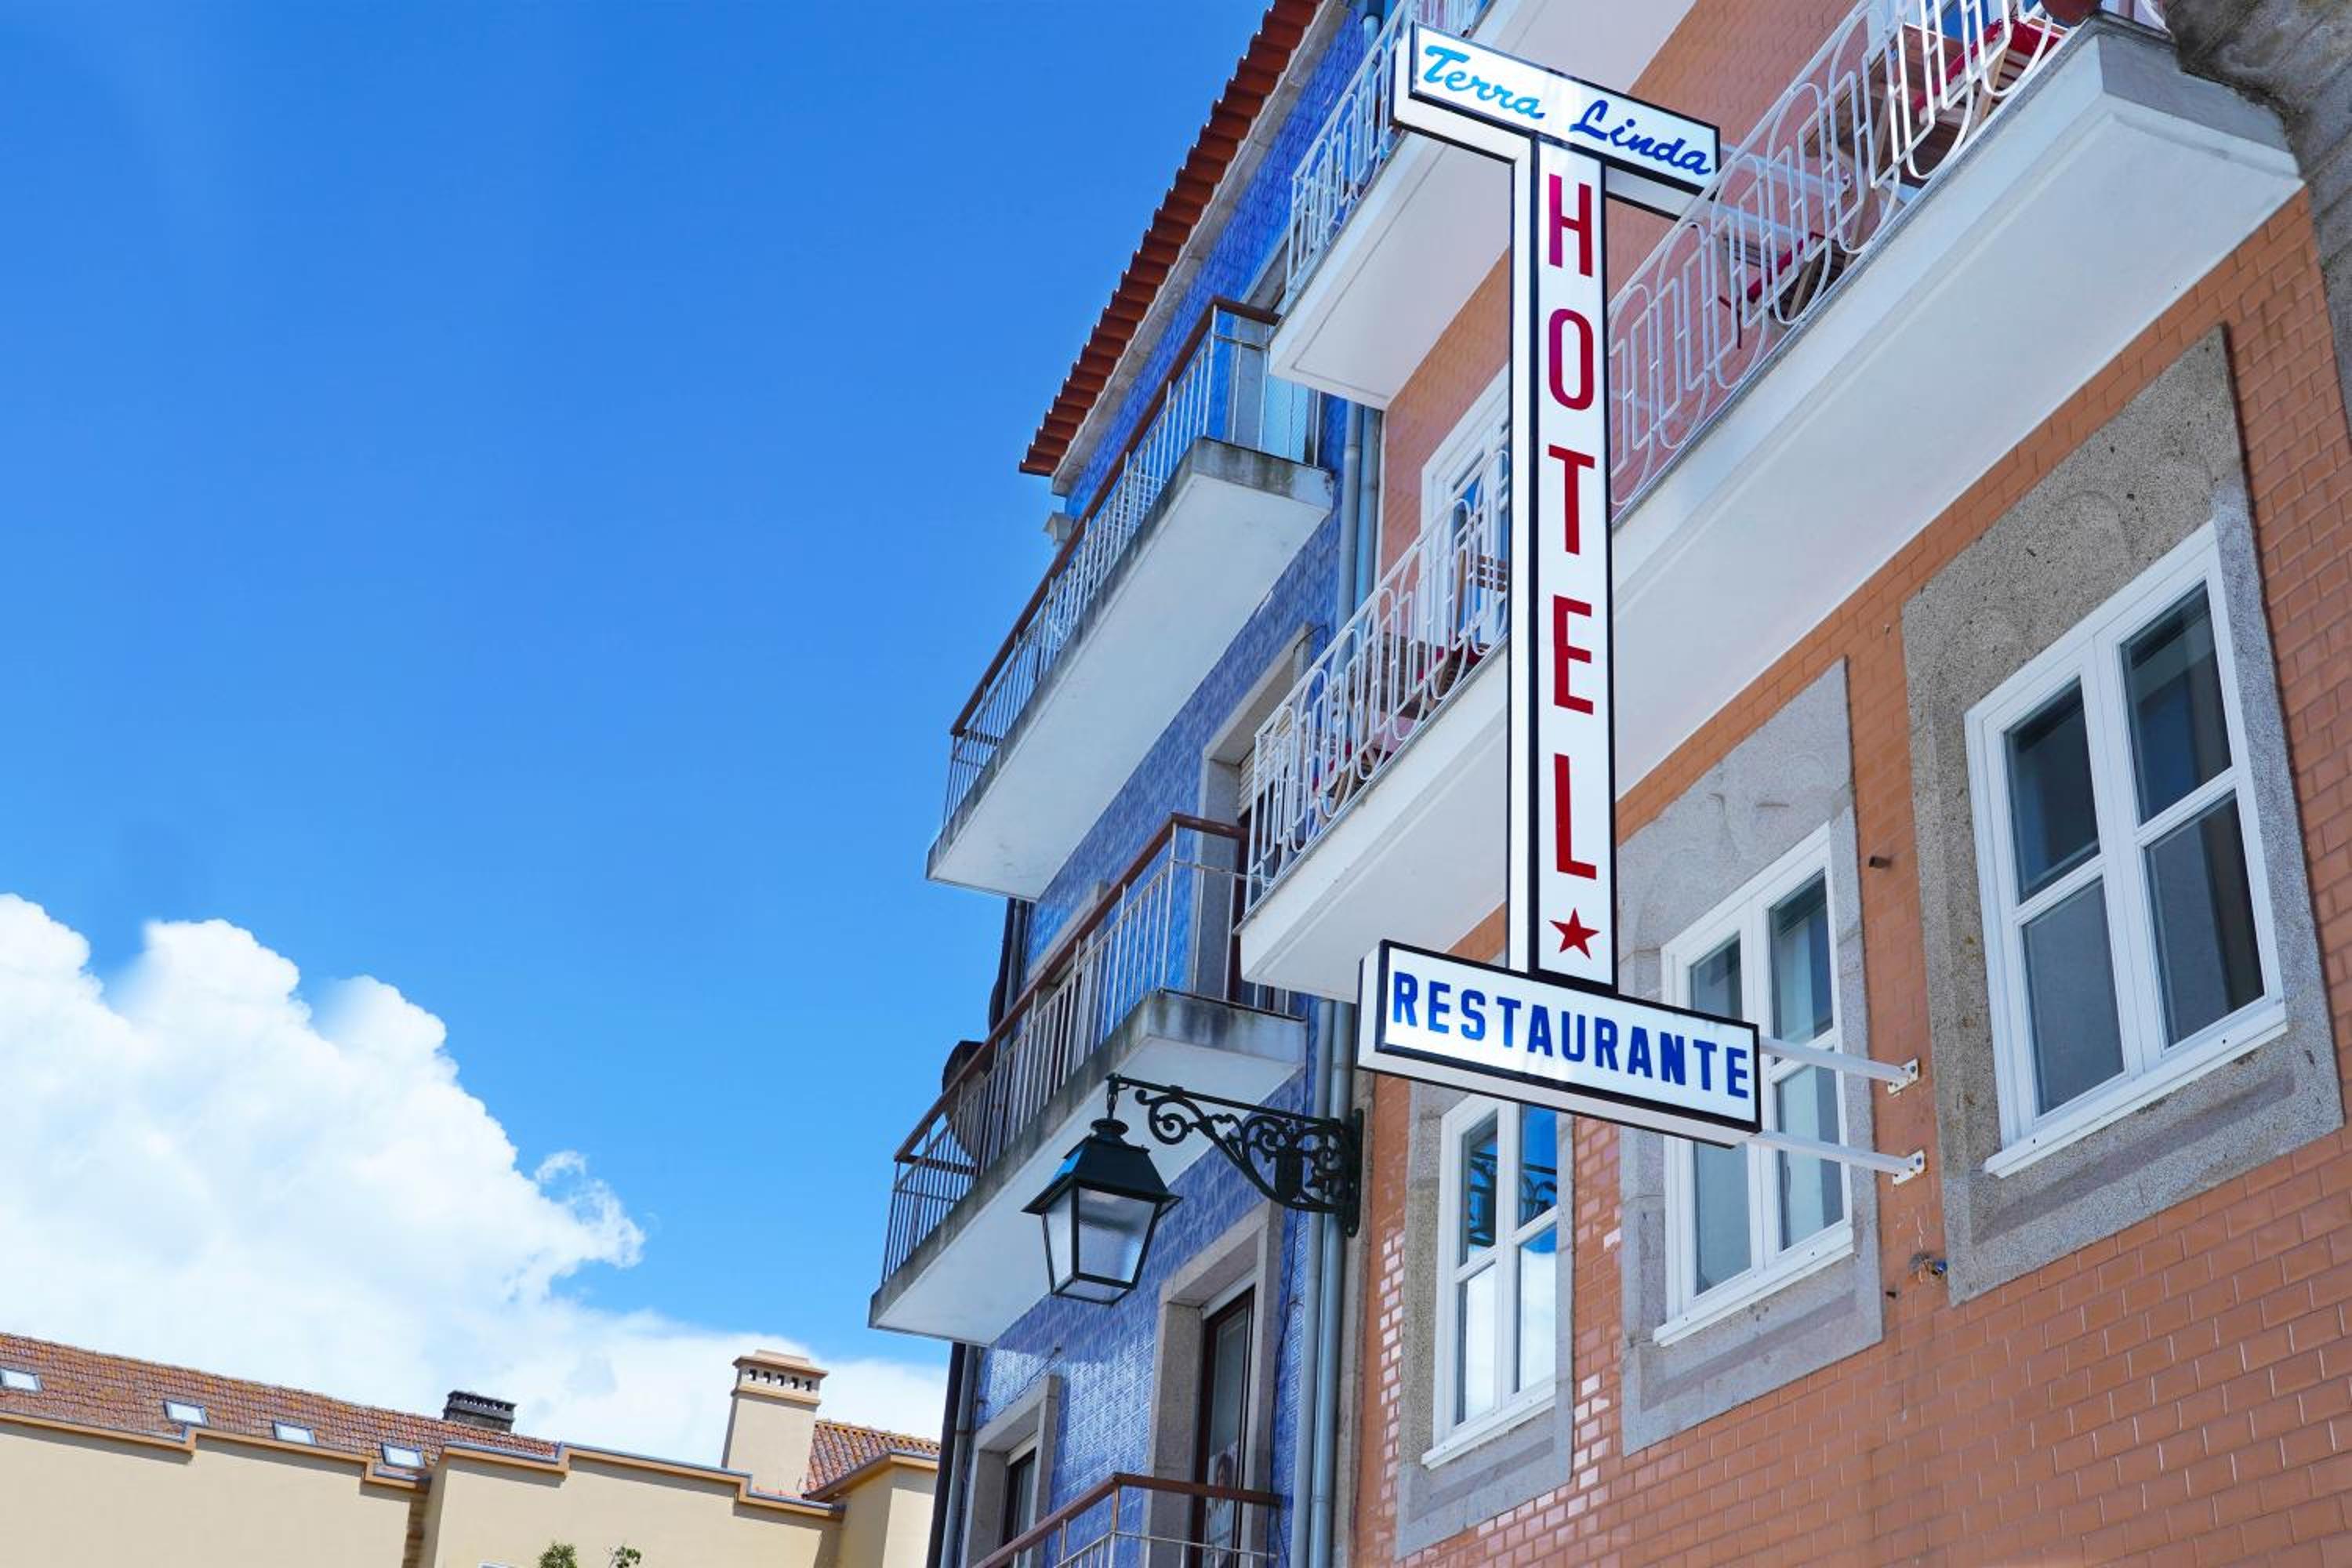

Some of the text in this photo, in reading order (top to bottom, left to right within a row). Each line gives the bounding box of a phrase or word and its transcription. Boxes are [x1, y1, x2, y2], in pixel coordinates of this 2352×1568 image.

[1423, 45, 1711, 176] Terra Linda
[1548, 173, 1597, 880] HOTEL
[1392, 971, 1749, 1099] RESTAURANTE
